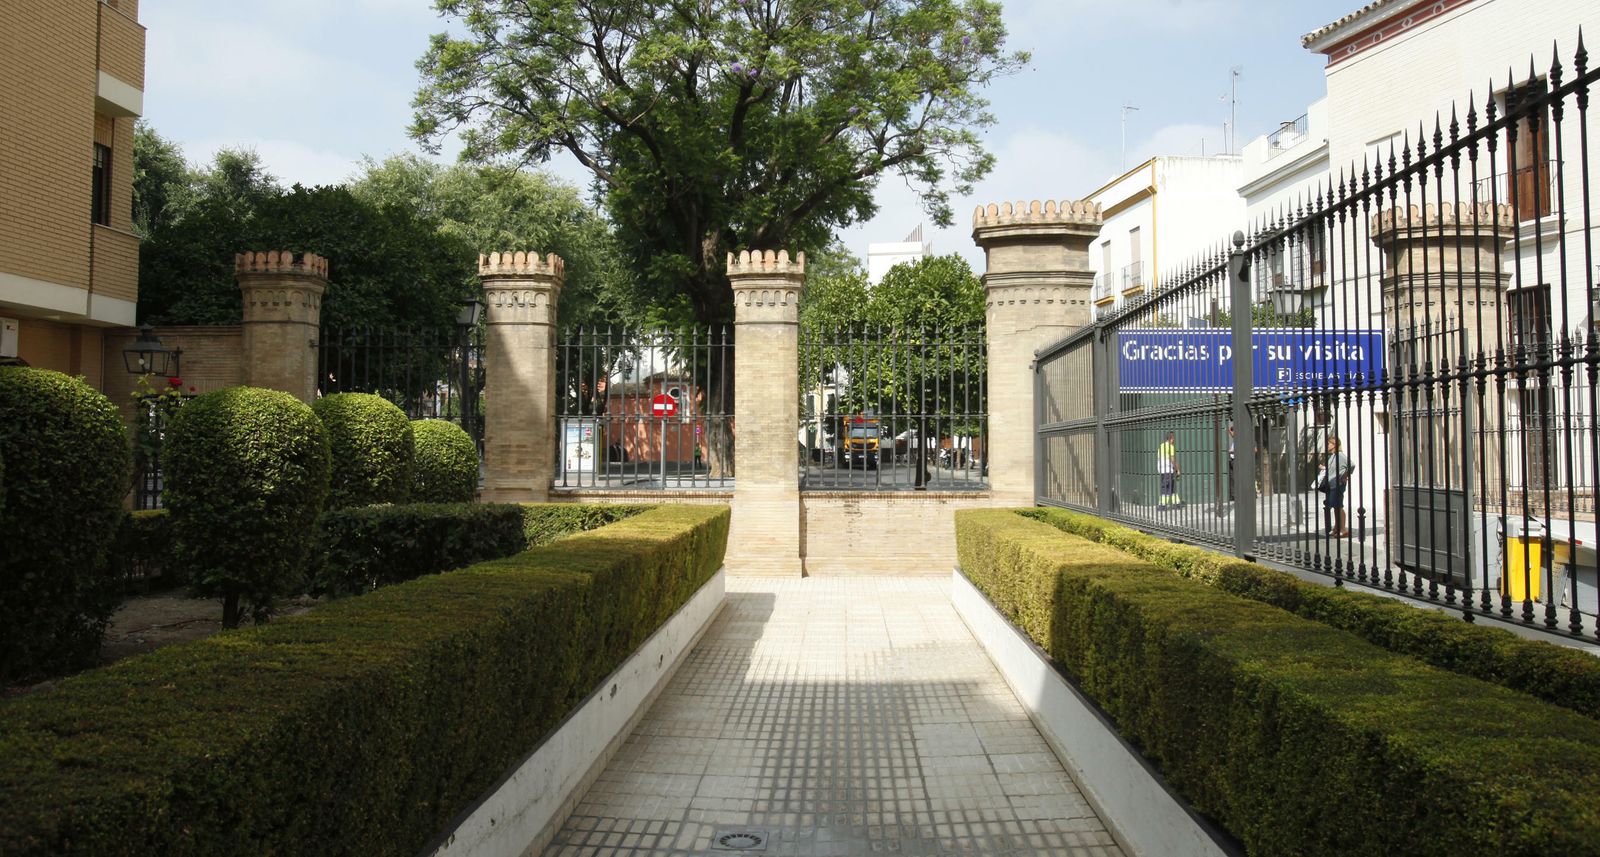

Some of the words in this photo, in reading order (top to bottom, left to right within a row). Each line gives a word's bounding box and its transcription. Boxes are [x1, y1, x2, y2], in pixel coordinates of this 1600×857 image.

[1122, 340, 1210, 361] Gracias
[1268, 345, 1291, 361] su
[1300, 340, 1364, 361] visita
[1294, 372, 1341, 380] ESCUEAS
